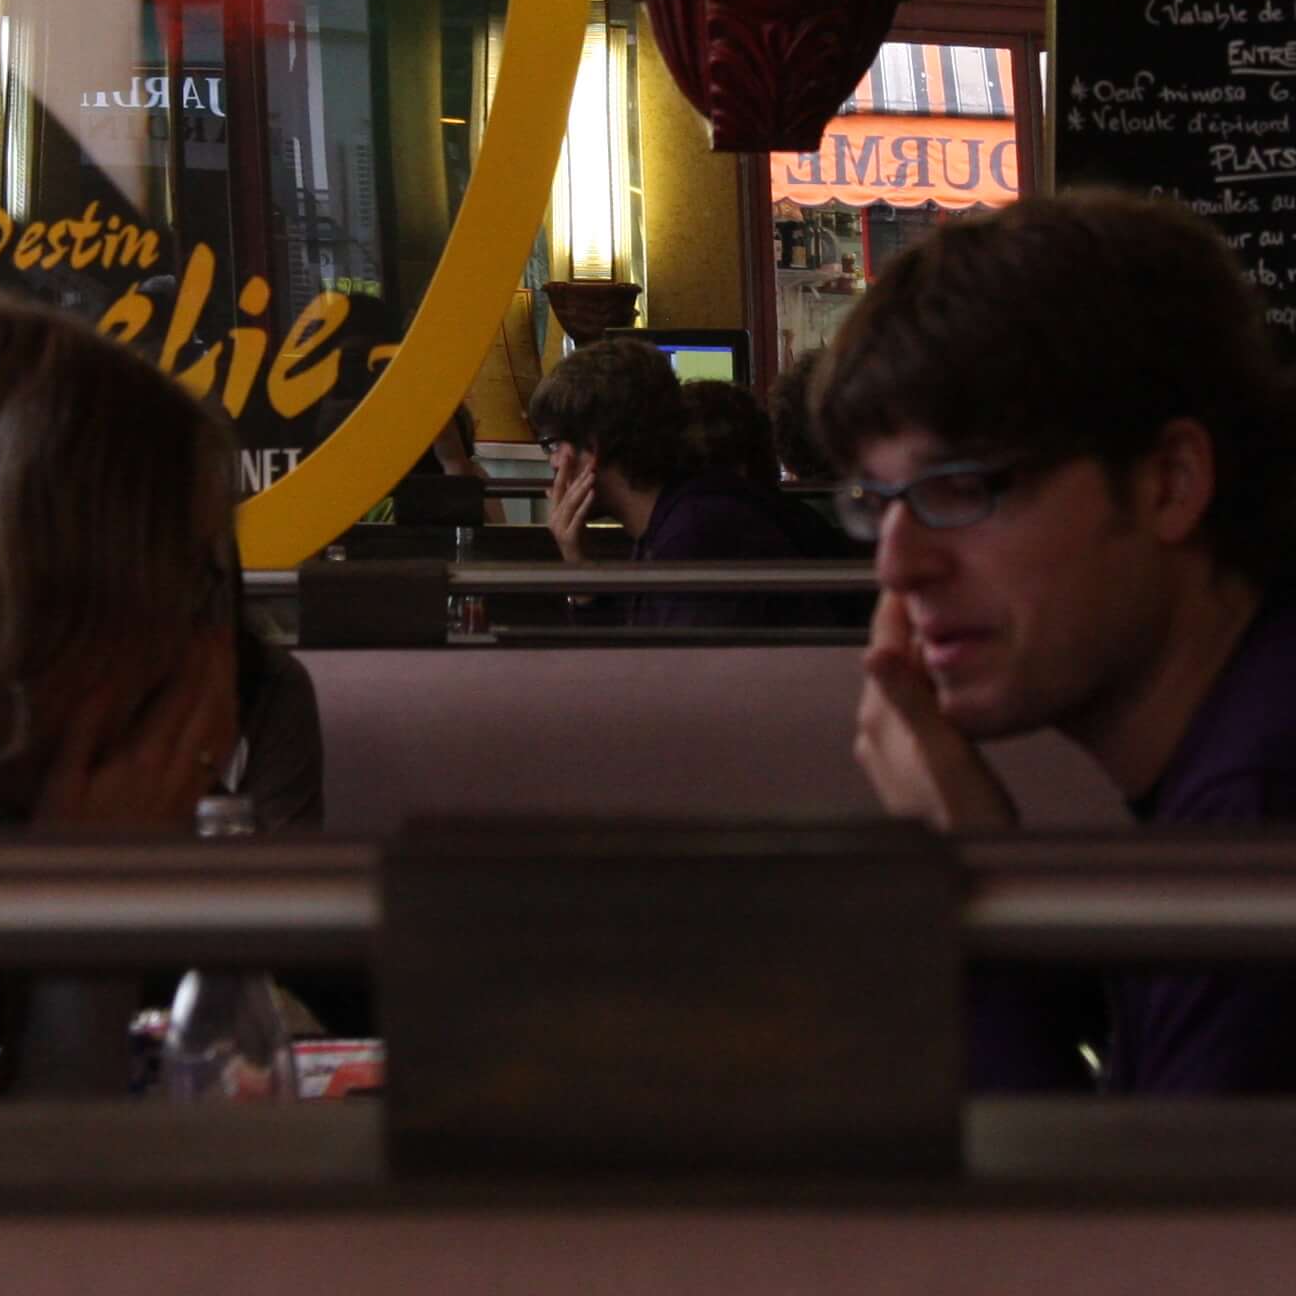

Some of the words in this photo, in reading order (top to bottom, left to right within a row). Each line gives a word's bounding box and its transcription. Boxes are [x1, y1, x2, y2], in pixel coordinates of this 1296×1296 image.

[1258, 0, 1285, 24] de
[1157, 80, 1248, 104] mimosa
[1271, 192, 1296, 213] au
[1258, 227, 1285, 247] au
